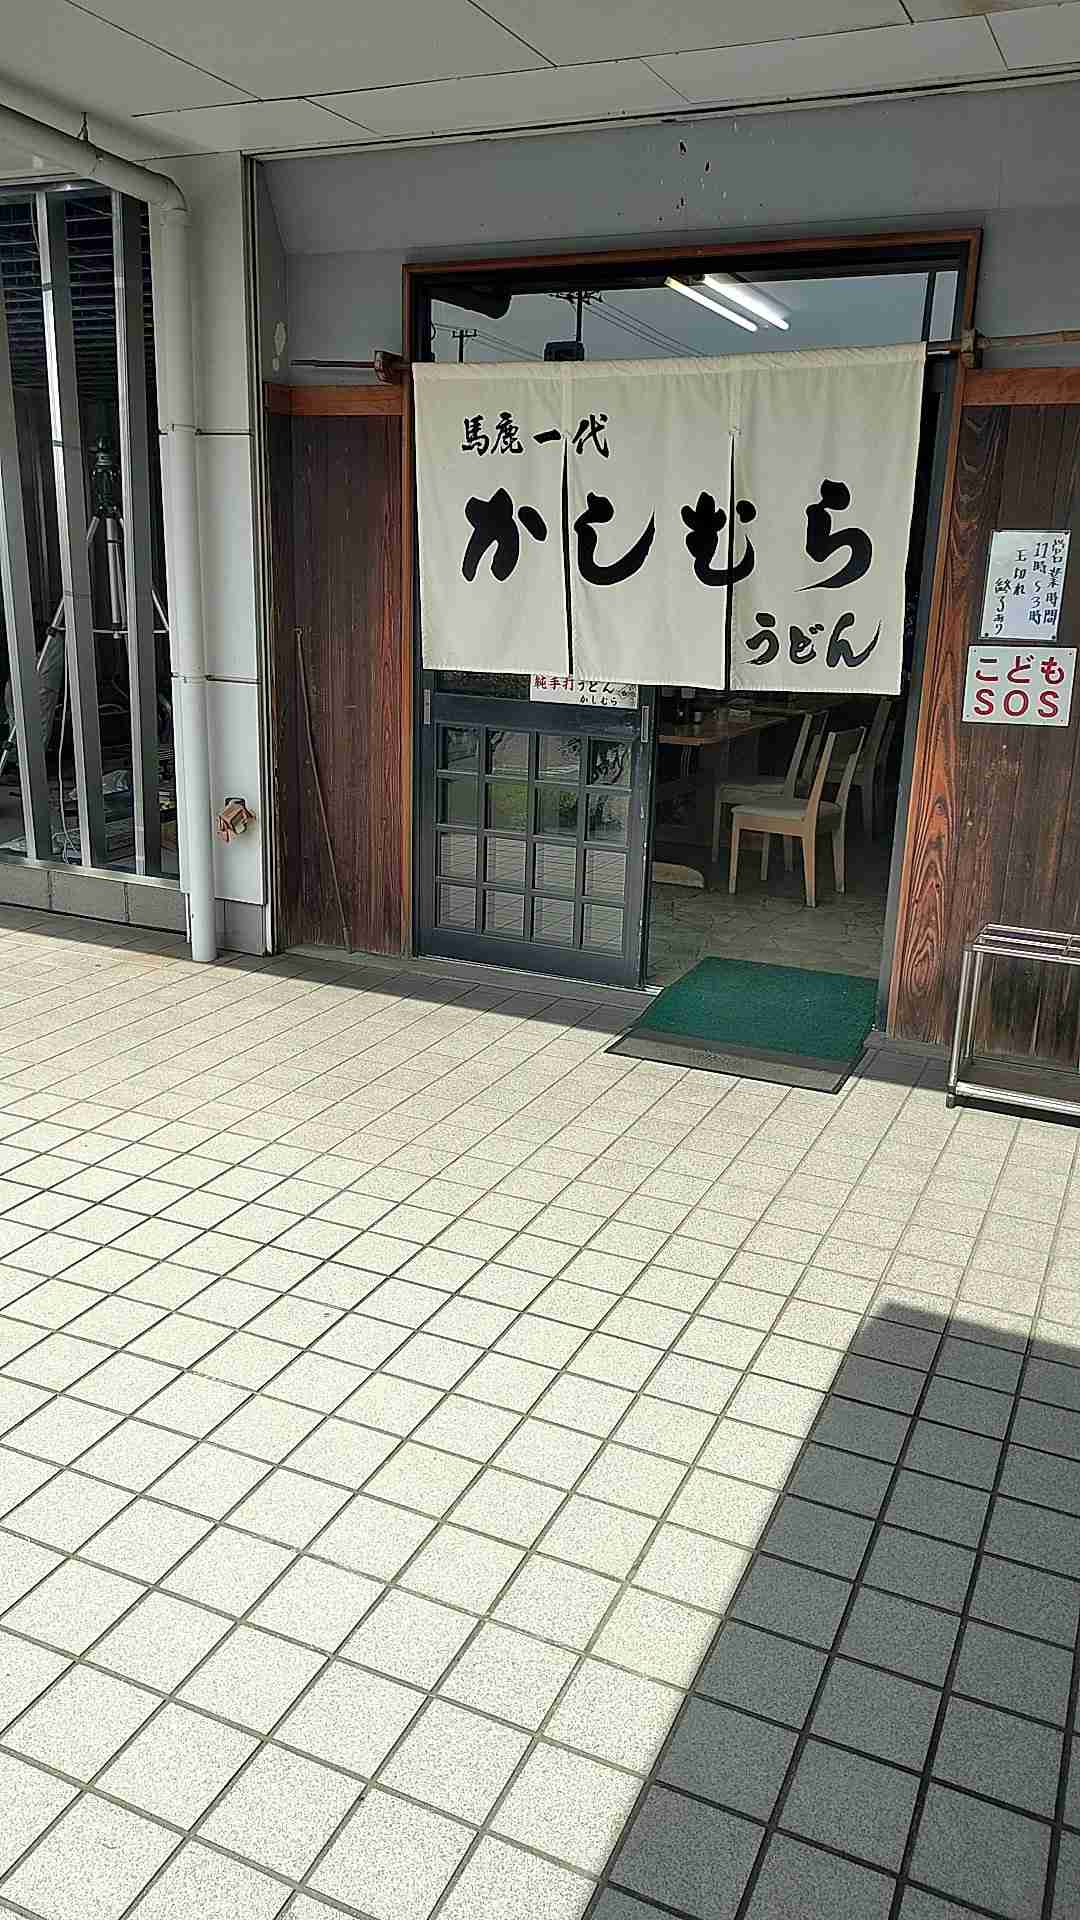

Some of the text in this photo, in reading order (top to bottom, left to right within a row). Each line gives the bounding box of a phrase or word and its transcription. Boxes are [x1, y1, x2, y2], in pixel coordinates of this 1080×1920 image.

[461, 412, 610, 458] 馬鹿一代
[461, 479, 873, 592] かしむら
[1043, 538, 1064, 625] 営業時間
[742, 612, 881, 668] うどん
[976, 655, 1064, 684] こども
[579, 695, 618, 706] かしむら
[974, 689, 1059, 718] SOS
